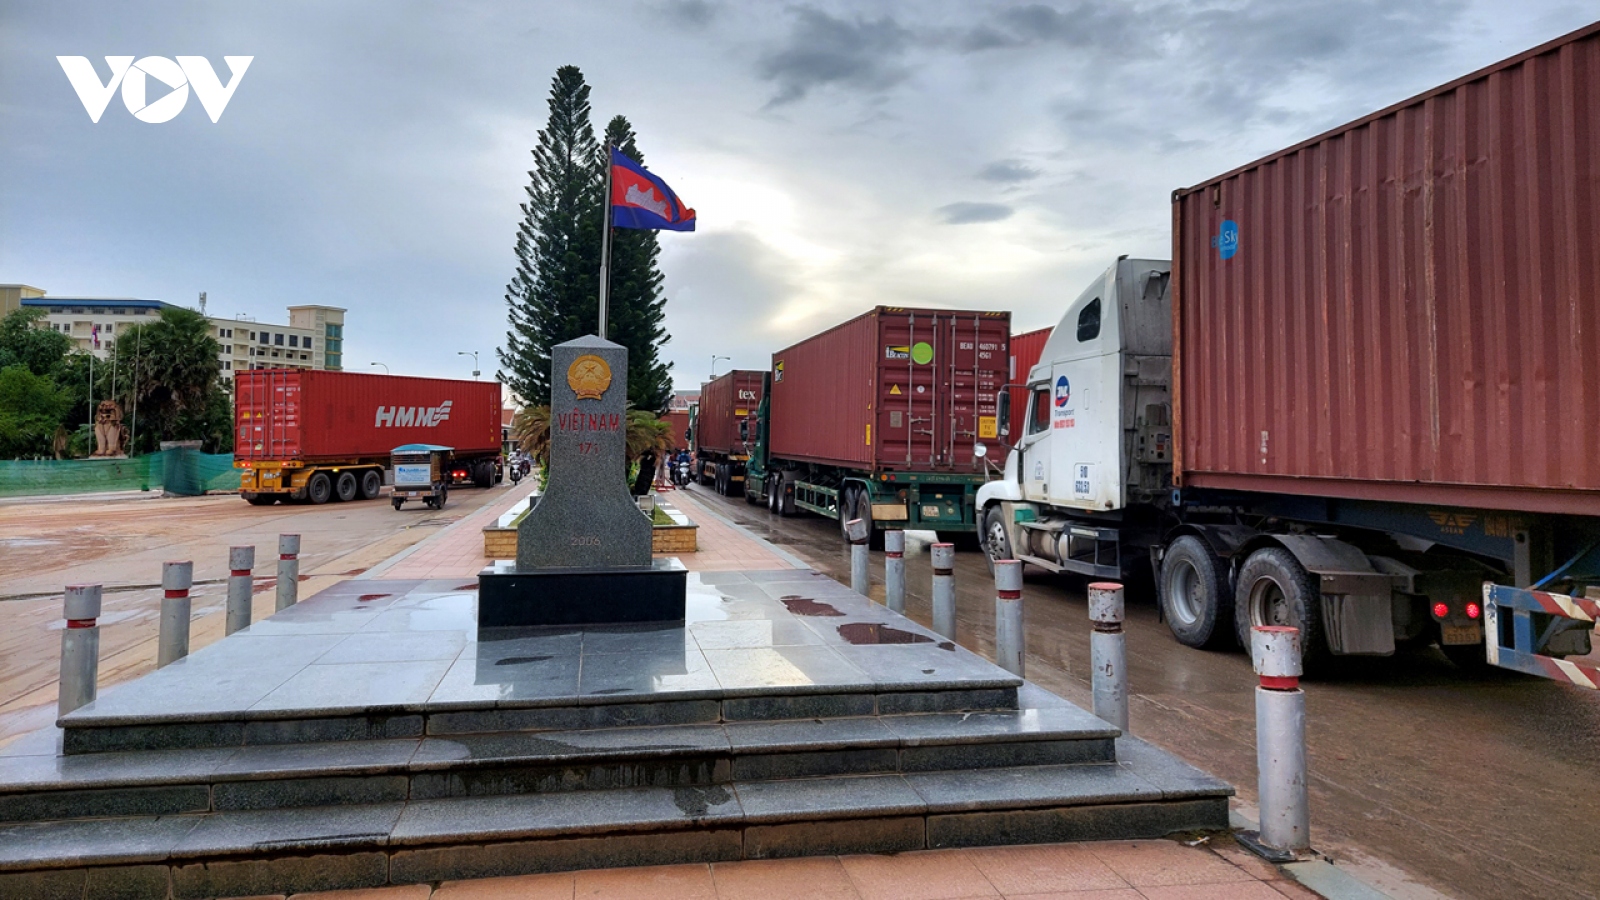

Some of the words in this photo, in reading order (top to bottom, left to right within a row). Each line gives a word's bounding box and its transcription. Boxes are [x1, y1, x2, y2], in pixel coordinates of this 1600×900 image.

[738, 389, 756, 400] tex
[375, 403, 448, 427] HMM
[1054, 409, 1075, 417] Transport
[588, 413, 619, 431] NAM
